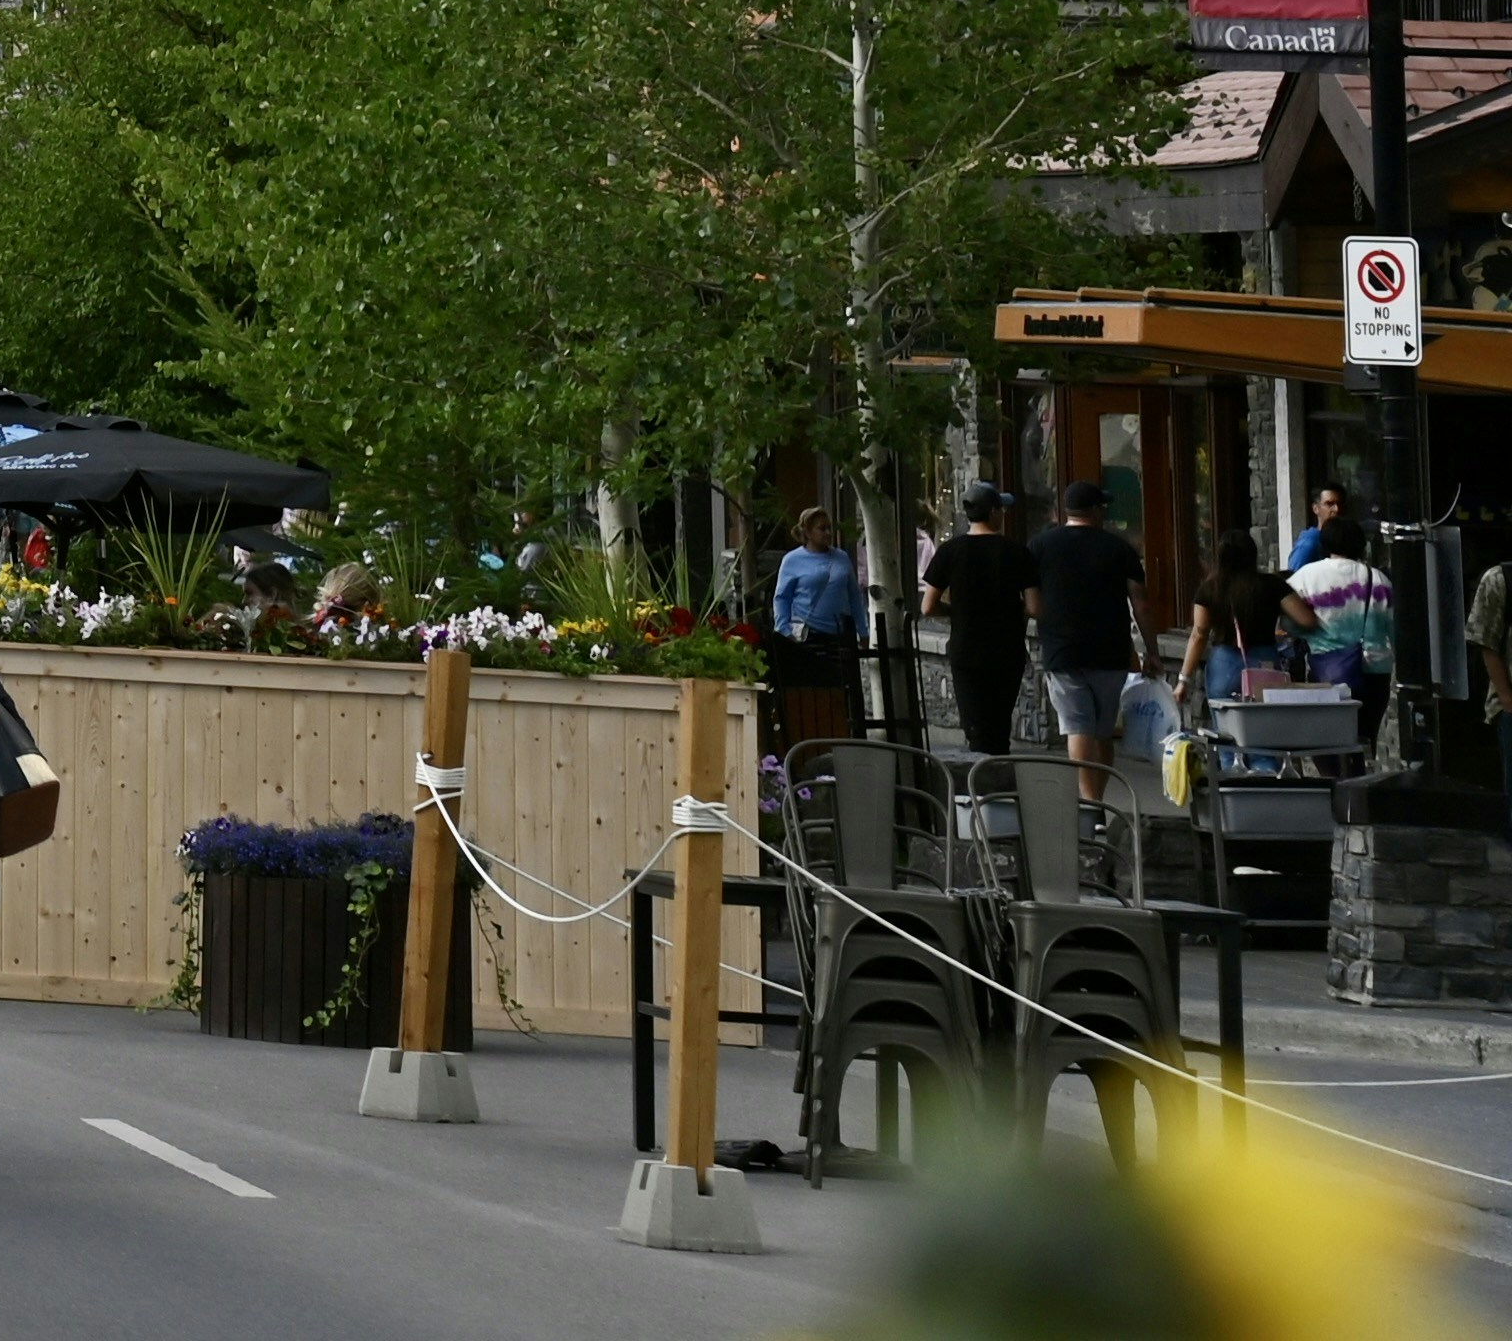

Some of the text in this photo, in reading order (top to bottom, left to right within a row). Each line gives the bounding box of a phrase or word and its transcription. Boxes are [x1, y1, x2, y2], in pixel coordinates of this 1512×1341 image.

[1225, 25, 1336, 53] Canada
[1374, 307, 1390, 320] NO
[1354, 322, 1412, 337] STOPPING
